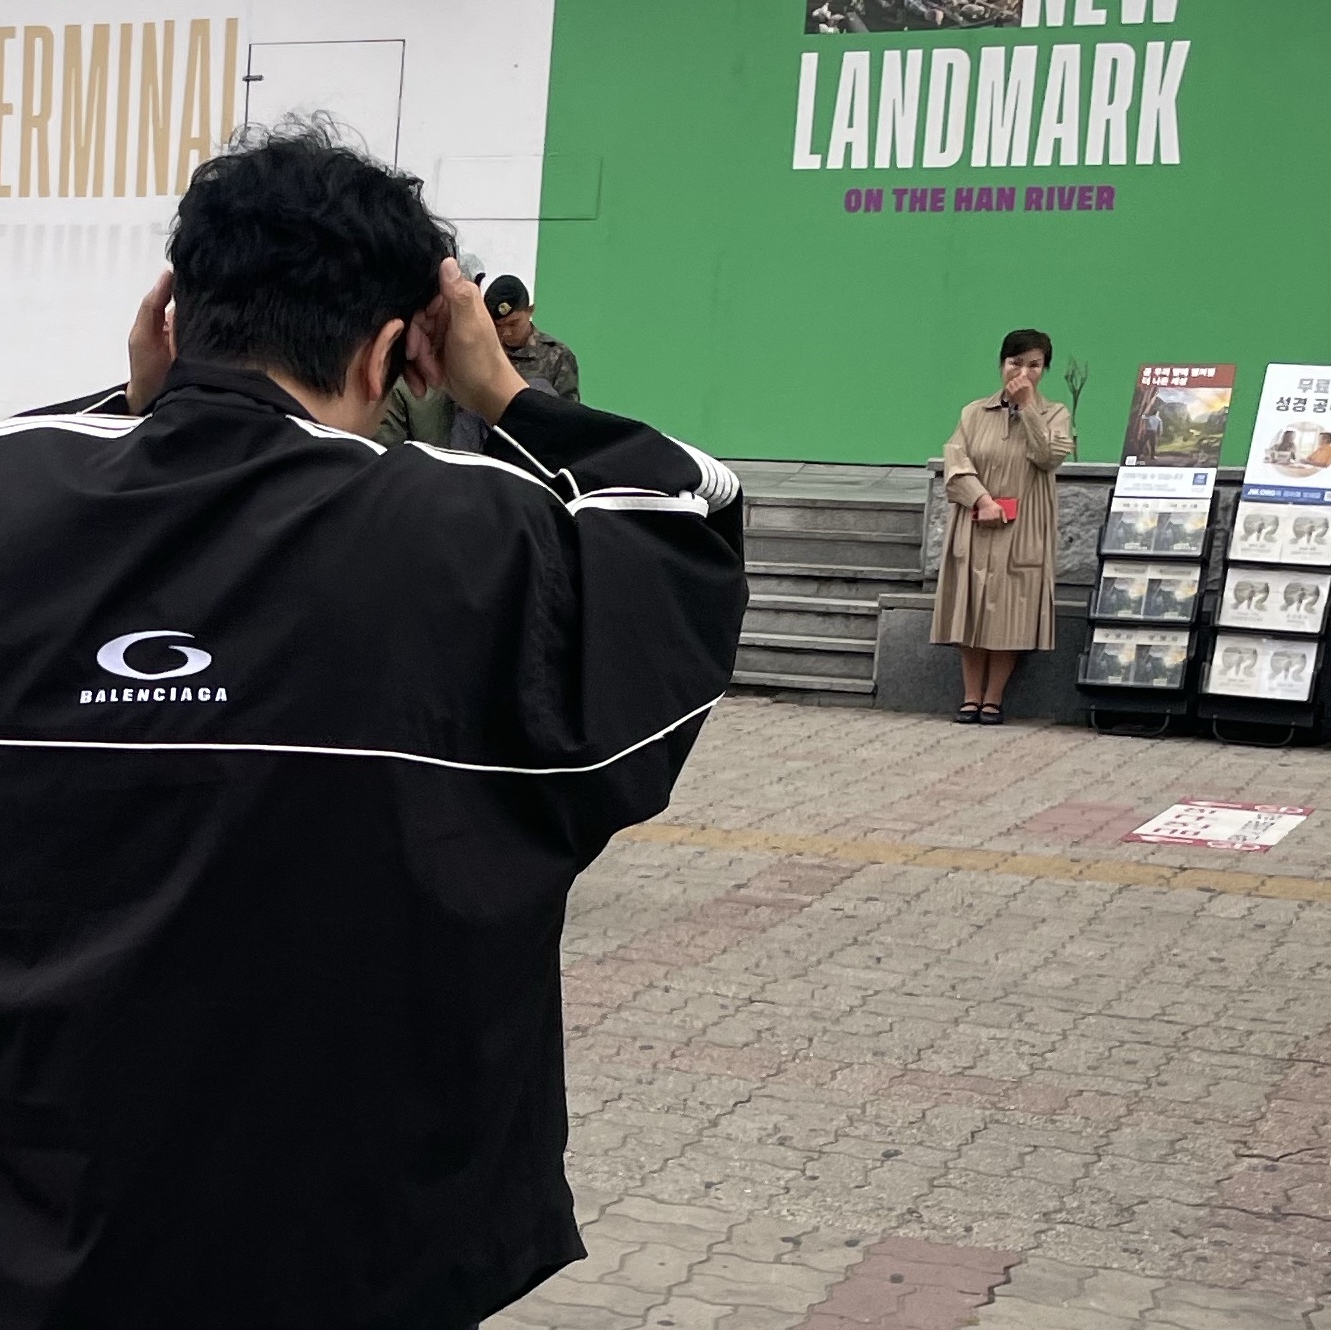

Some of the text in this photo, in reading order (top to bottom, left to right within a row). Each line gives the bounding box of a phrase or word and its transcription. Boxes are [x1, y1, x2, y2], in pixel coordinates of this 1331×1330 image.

[792, 40, 1191, 170] LANDMARK
[844, 185, 1116, 213] ON THE HAN RIVER
[1297, 378, 1331, 394] 무료
[1276, 397, 1331, 414] 성경 공
[80, 687, 228, 704] BALENCIAGA
